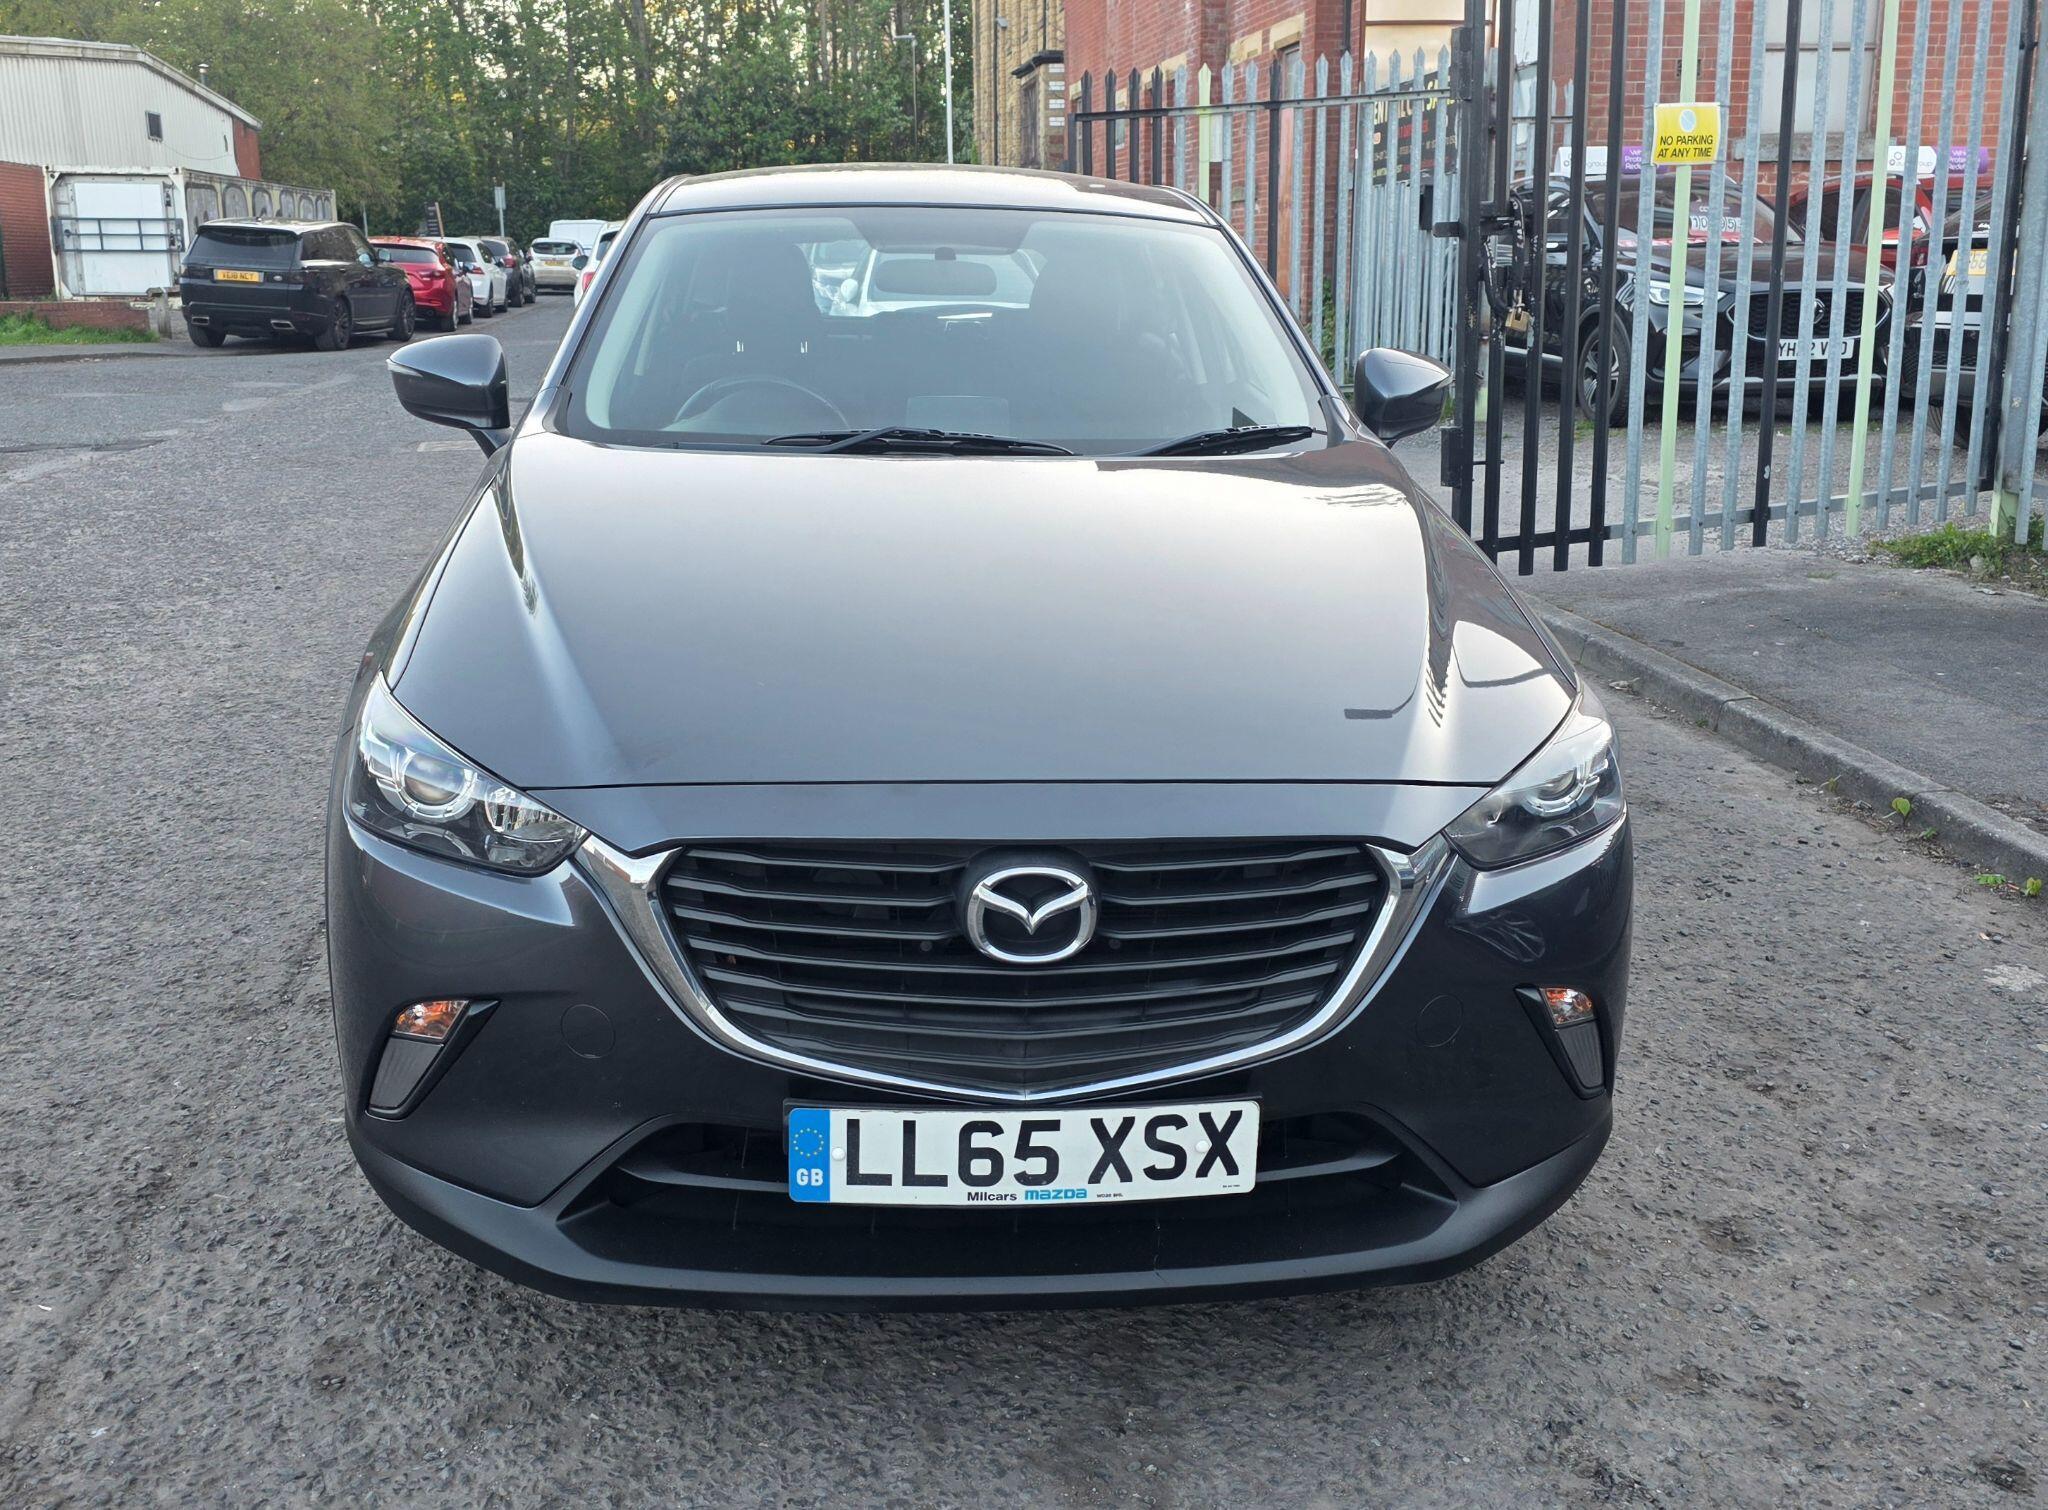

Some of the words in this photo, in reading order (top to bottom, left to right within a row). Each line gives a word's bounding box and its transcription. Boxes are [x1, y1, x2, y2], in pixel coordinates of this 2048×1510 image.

[1660, 135, 1673, 146] NO
[1676, 134, 1714, 146] PARKING
[1657, 148, 1669, 158] AT
[1670, 147, 1691, 158] ANY
[1692, 147, 1713, 158] TIME
[846, 1118, 1061, 1188] LL65
[1087, 1110, 1244, 1185] XSX
[795, 1168, 824, 1187] GB
[967, 1190, 1018, 1203] Milcars
[1024, 1188, 1088, 1201] mazda
